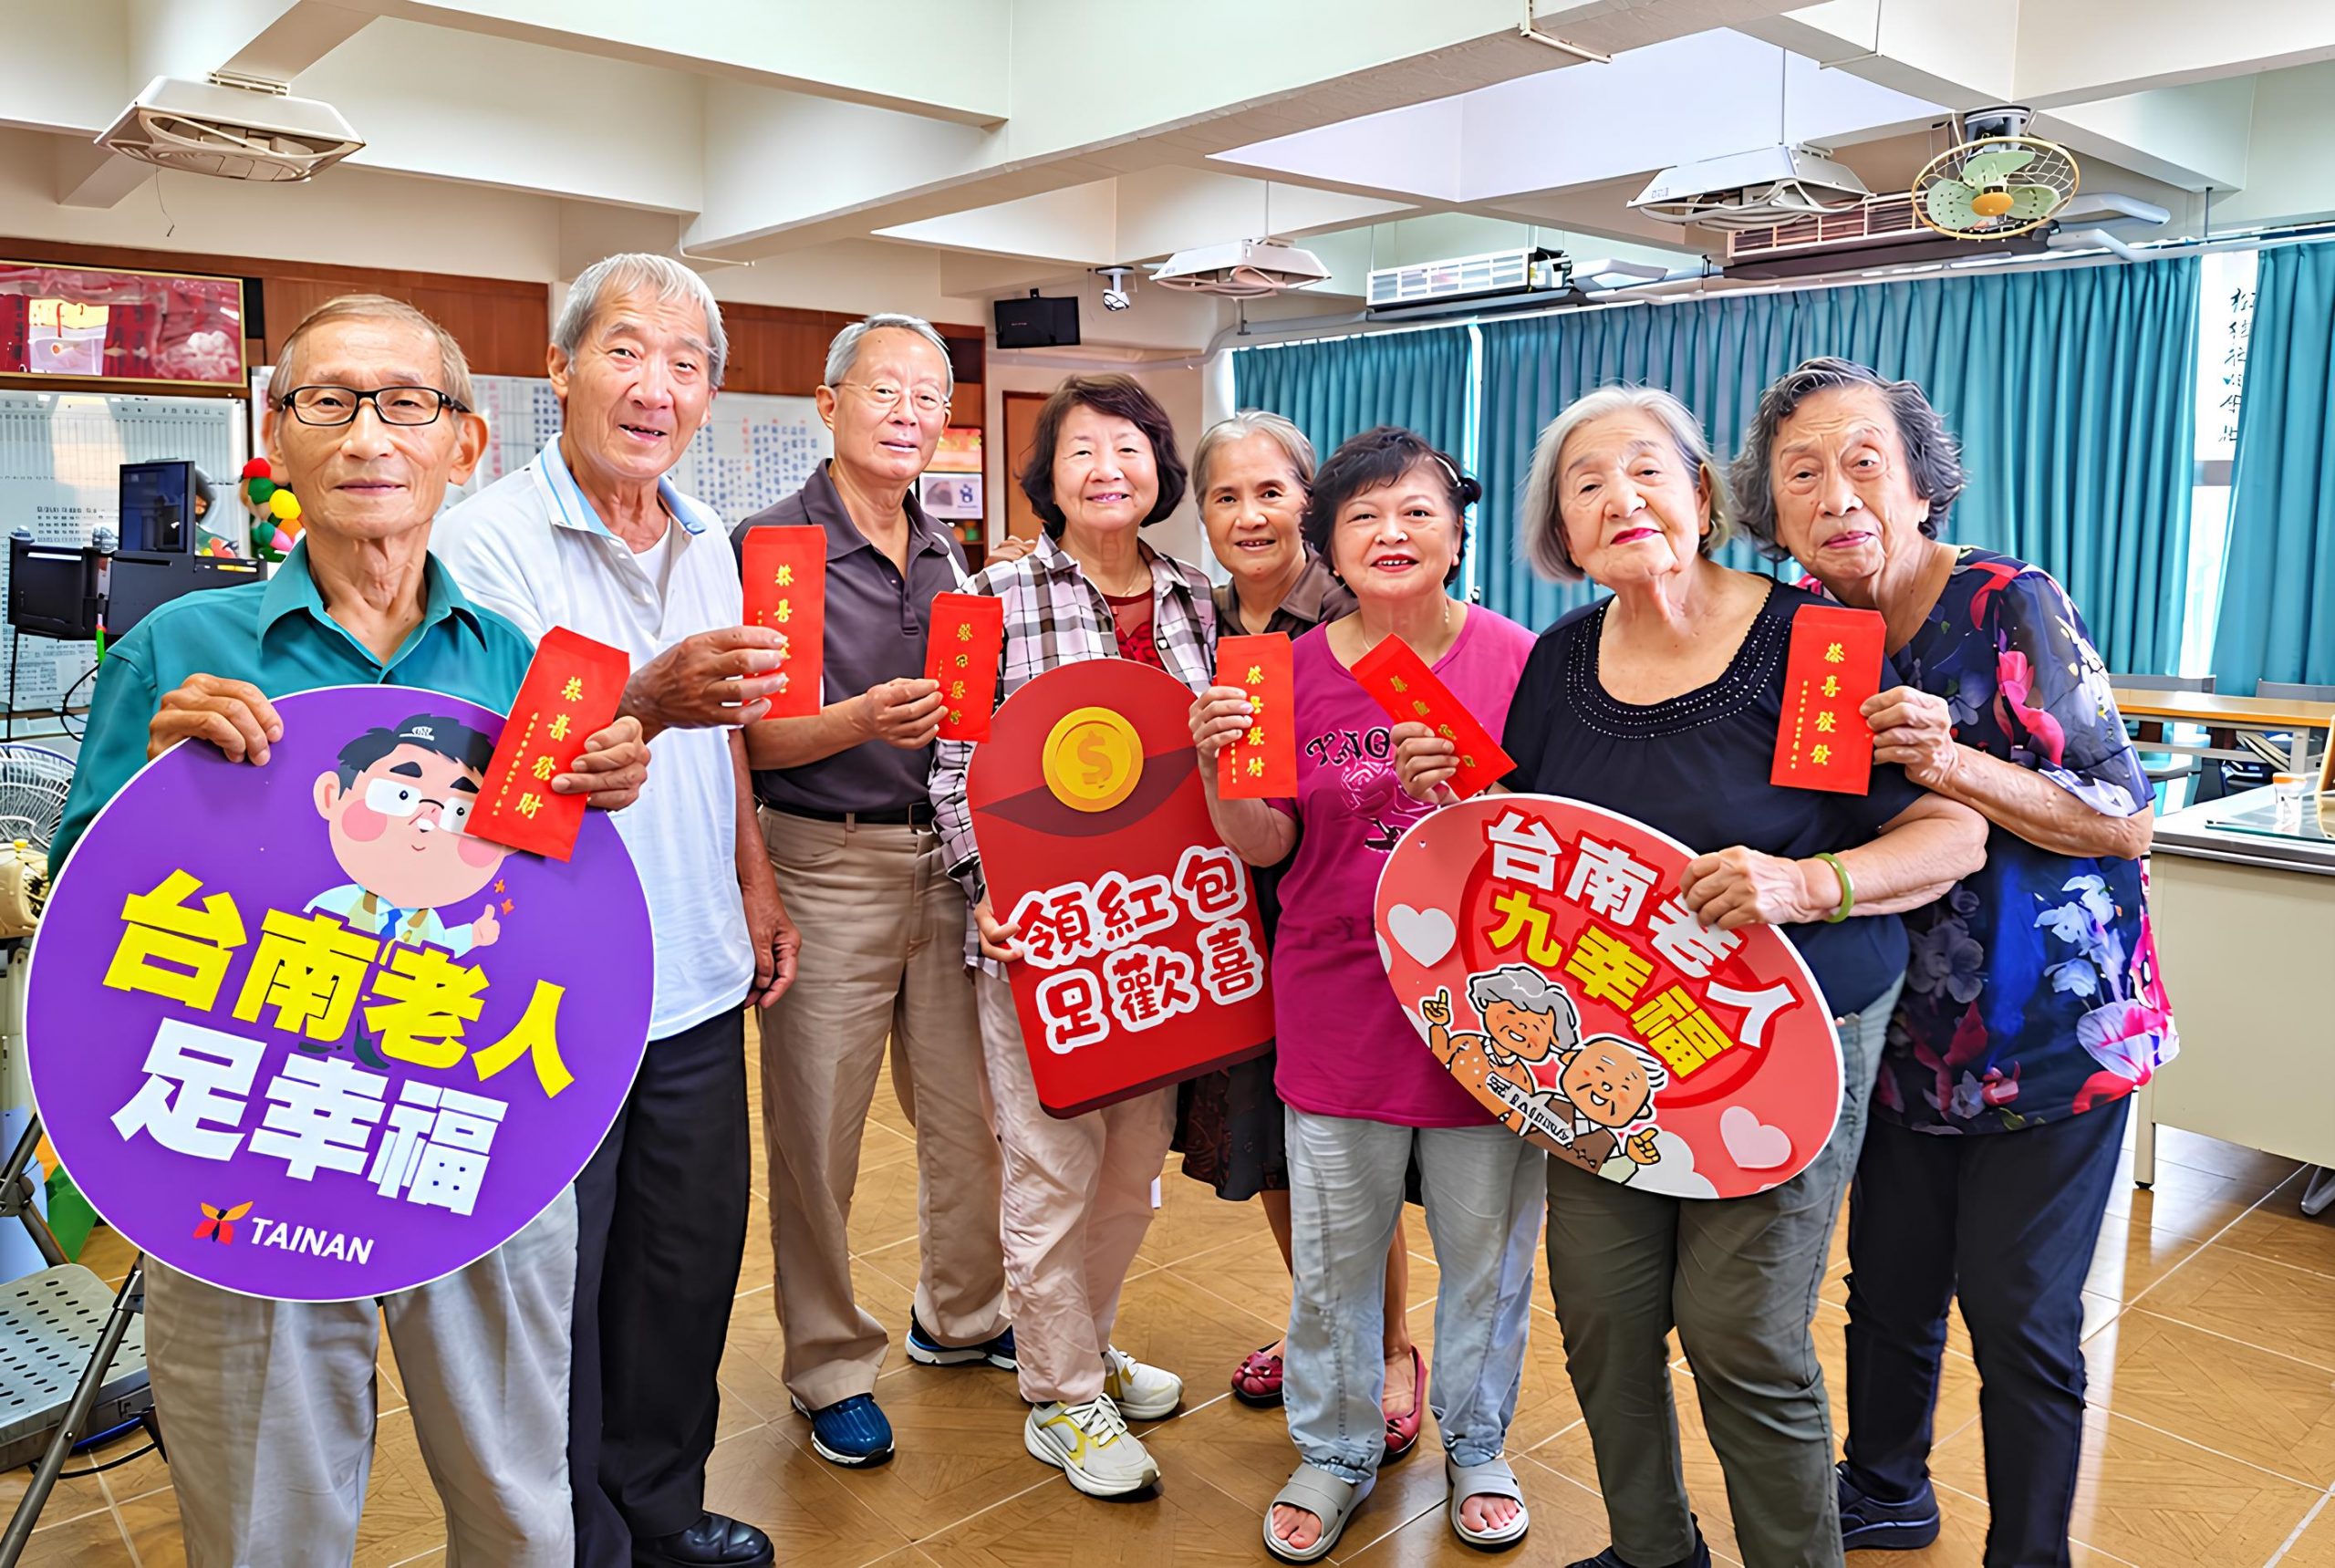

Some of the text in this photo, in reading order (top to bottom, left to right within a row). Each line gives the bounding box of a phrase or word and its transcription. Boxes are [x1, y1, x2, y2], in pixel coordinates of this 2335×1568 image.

[515, 676, 584, 819] 恭喜發財
[102, 868, 575, 1098] 台南老人
[1012, 849, 1245, 965] 領紅包
[1042, 923, 1259, 1049] 足歡喜
[1488, 811, 1797, 1048] 台南老人
[1488, 890, 1734, 1078] 九幸福
[110, 1016, 509, 1216] 足幸福
[251, 1217, 375, 1265] TAINAN
